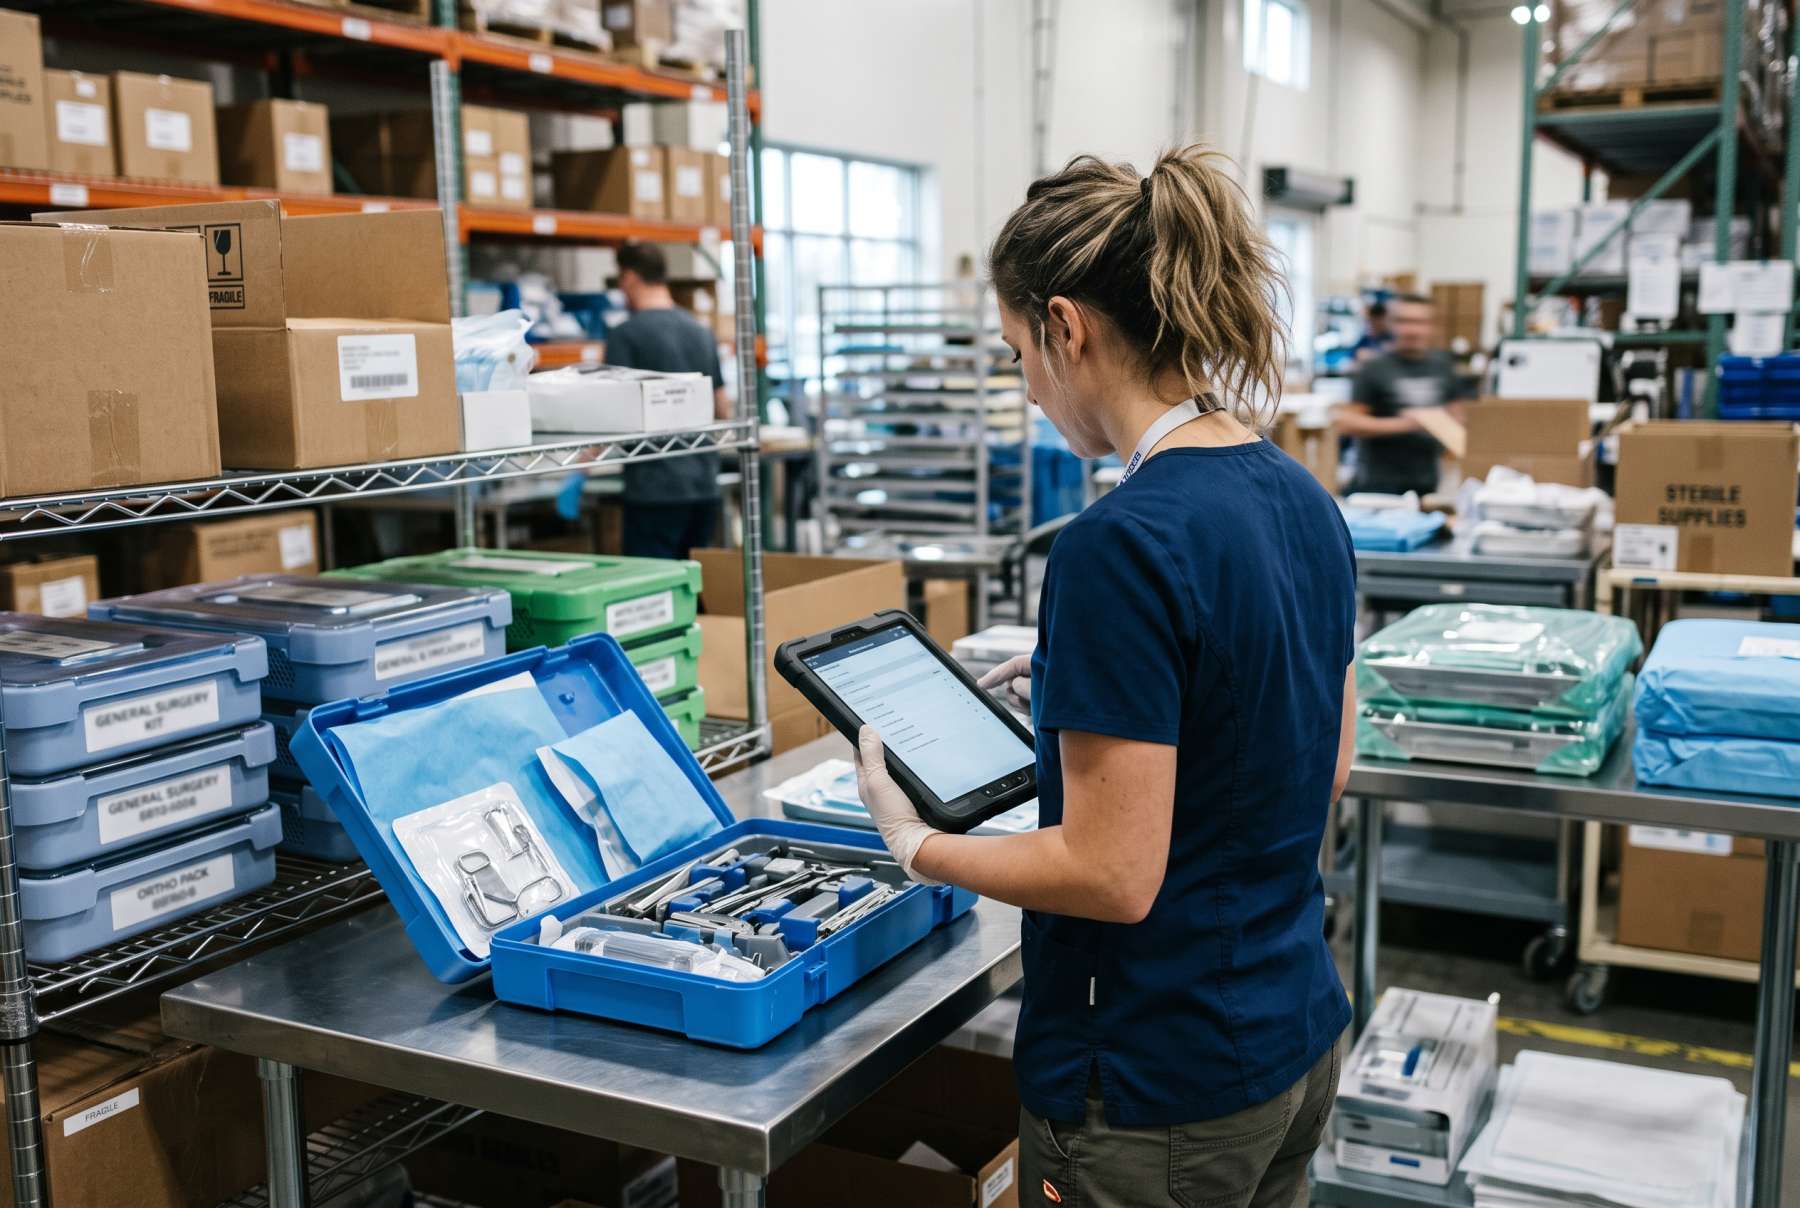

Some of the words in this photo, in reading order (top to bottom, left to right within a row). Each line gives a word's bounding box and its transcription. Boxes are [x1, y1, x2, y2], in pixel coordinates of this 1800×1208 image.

[209, 291, 242, 303] FRAGILE
[1665, 484, 1741, 503] STERILE
[1659, 506, 1747, 527] SUPPLIES
[95, 704, 152, 728] GENERAL
[155, 690, 209, 713] SURGERY
[108, 791, 163, 815] GENERAL
[166, 774, 218, 799] SURGERY
[137, 878, 178, 901] ORTHO
[180, 867, 209, 885] PACK
[84, 1101, 119, 1122] FRAGILE
